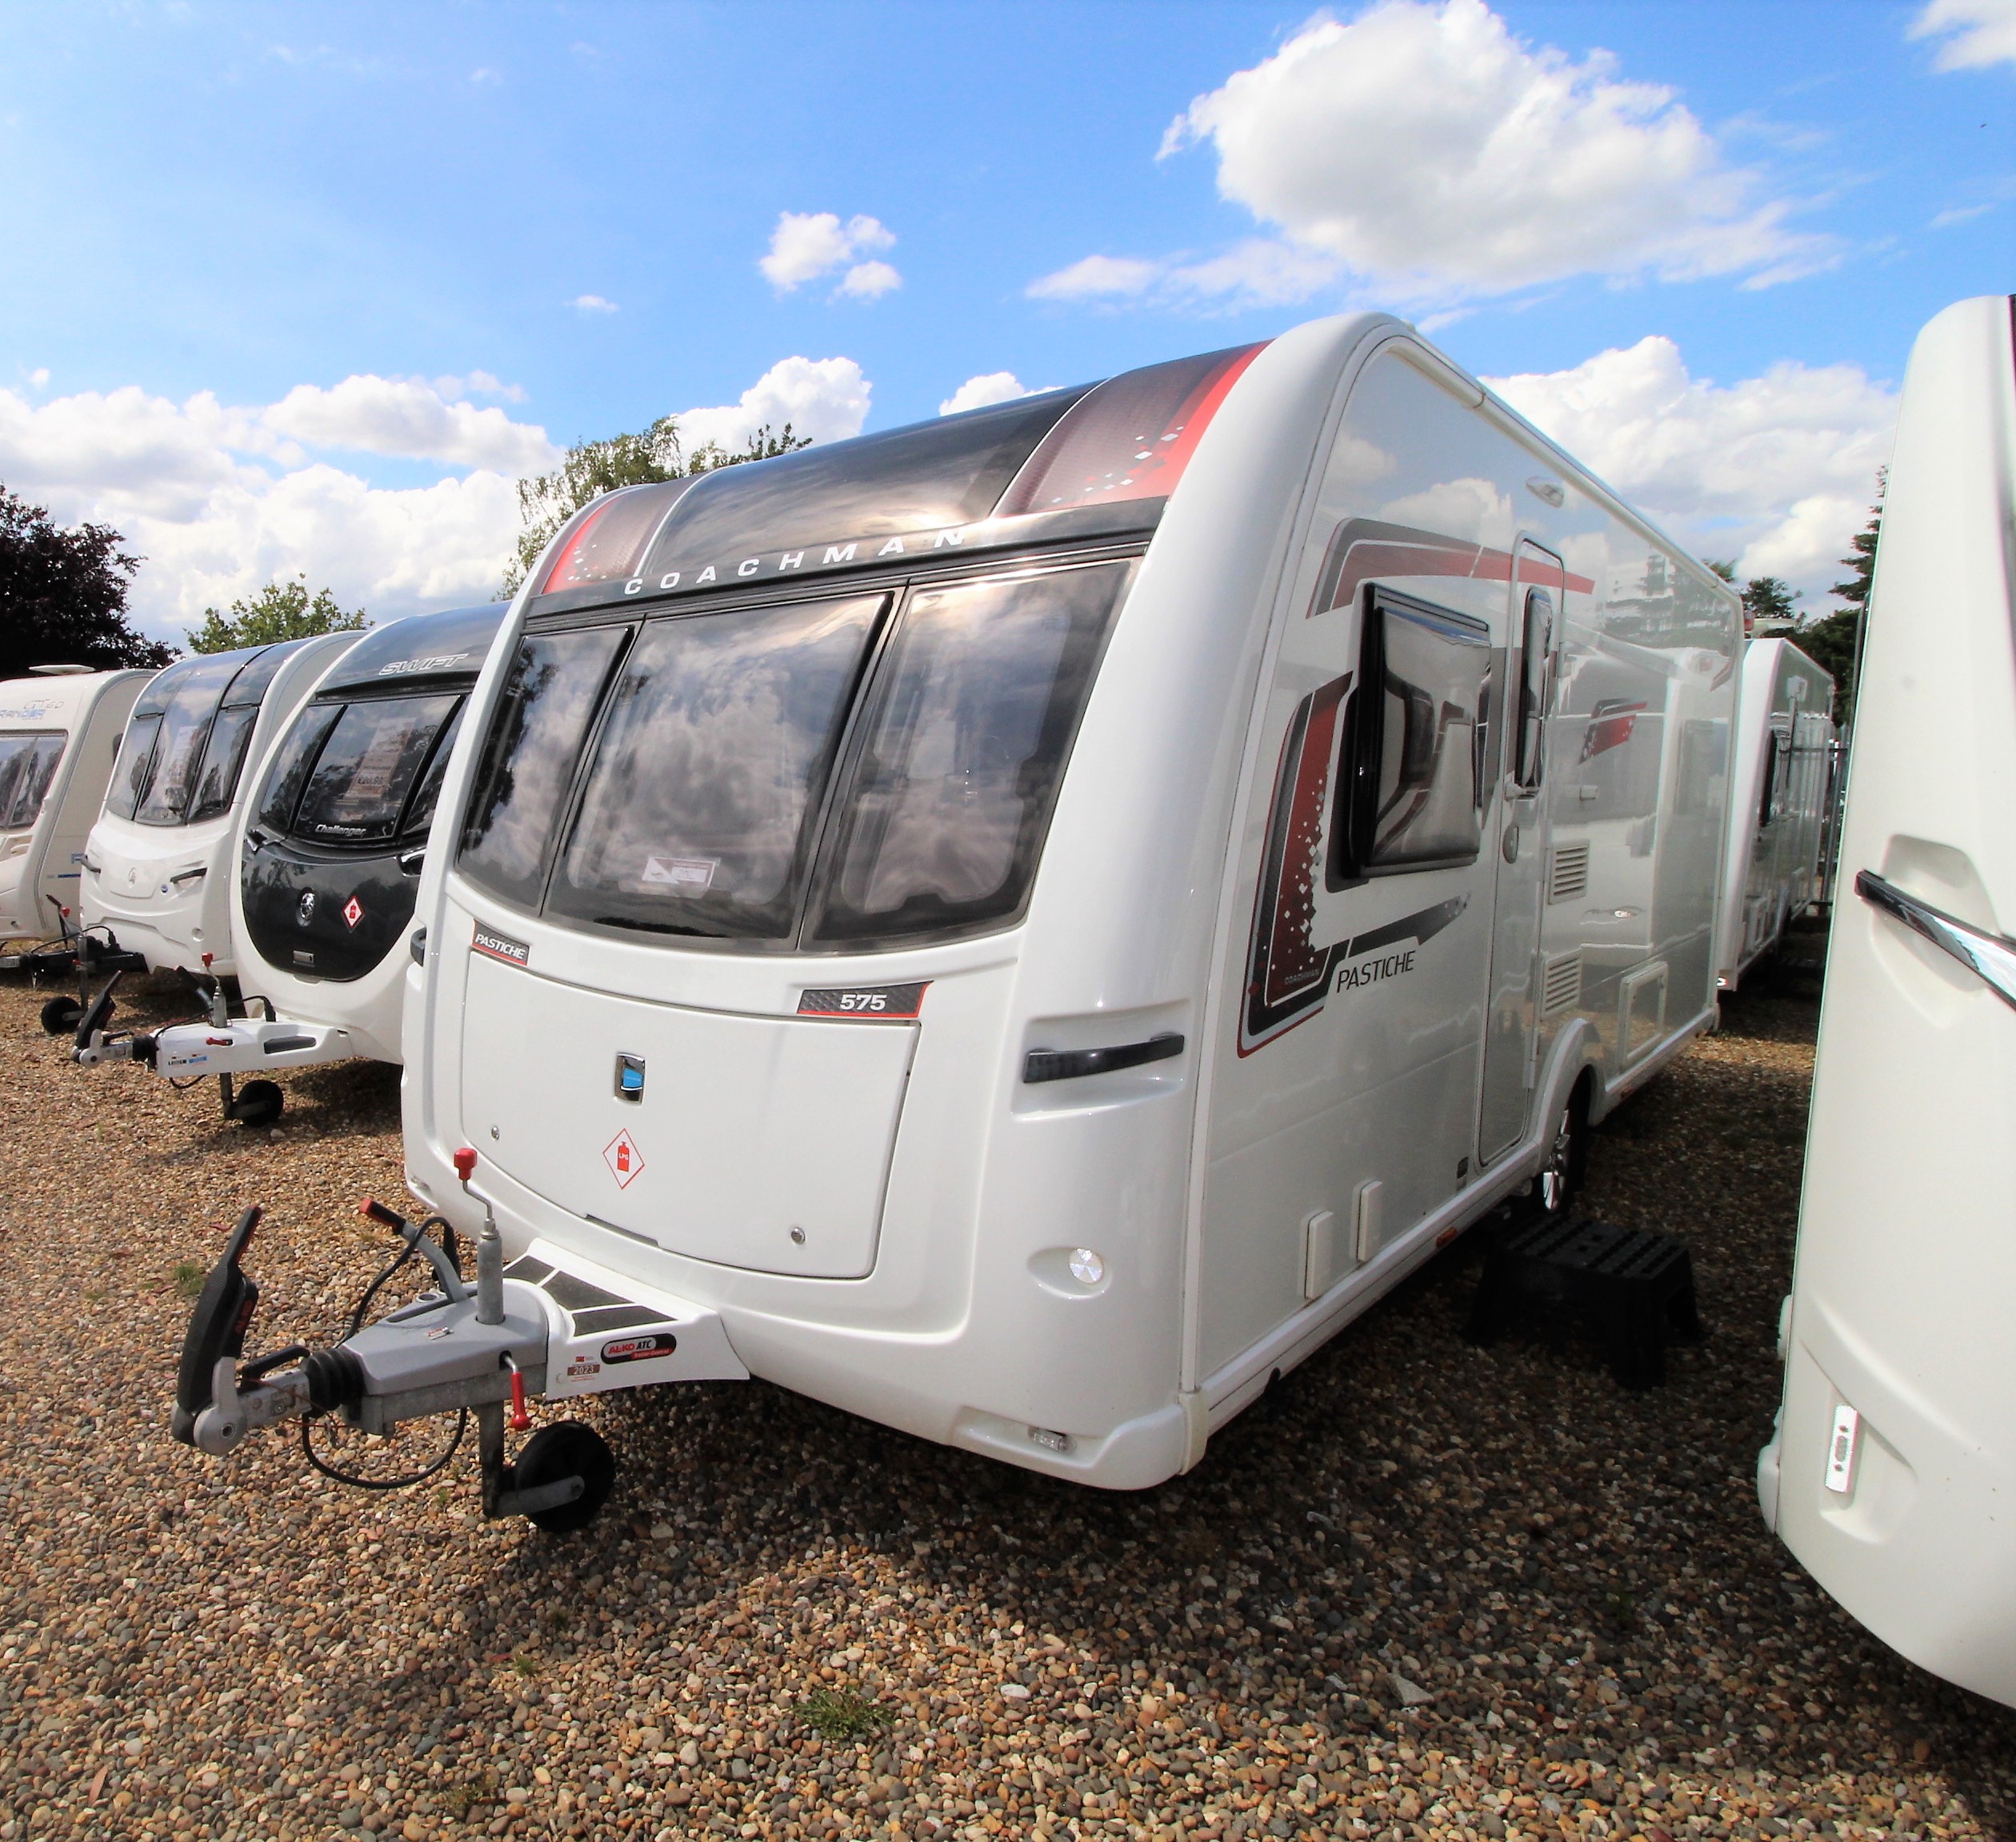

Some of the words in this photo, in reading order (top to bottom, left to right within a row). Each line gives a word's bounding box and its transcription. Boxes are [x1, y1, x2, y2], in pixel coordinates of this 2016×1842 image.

[624, 529, 965, 595] COACHMAN
[378, 653, 469, 676] SWIFT
[315, 824, 366, 837] Challenger
[475, 933, 526, 959] PASTICHE
[1337, 950, 1416, 993] PASTICHE
[840, 994, 887, 1011] 575
[636, 1341, 652, 1350] ATC
[574, 1365, 594, 1376] 2023
